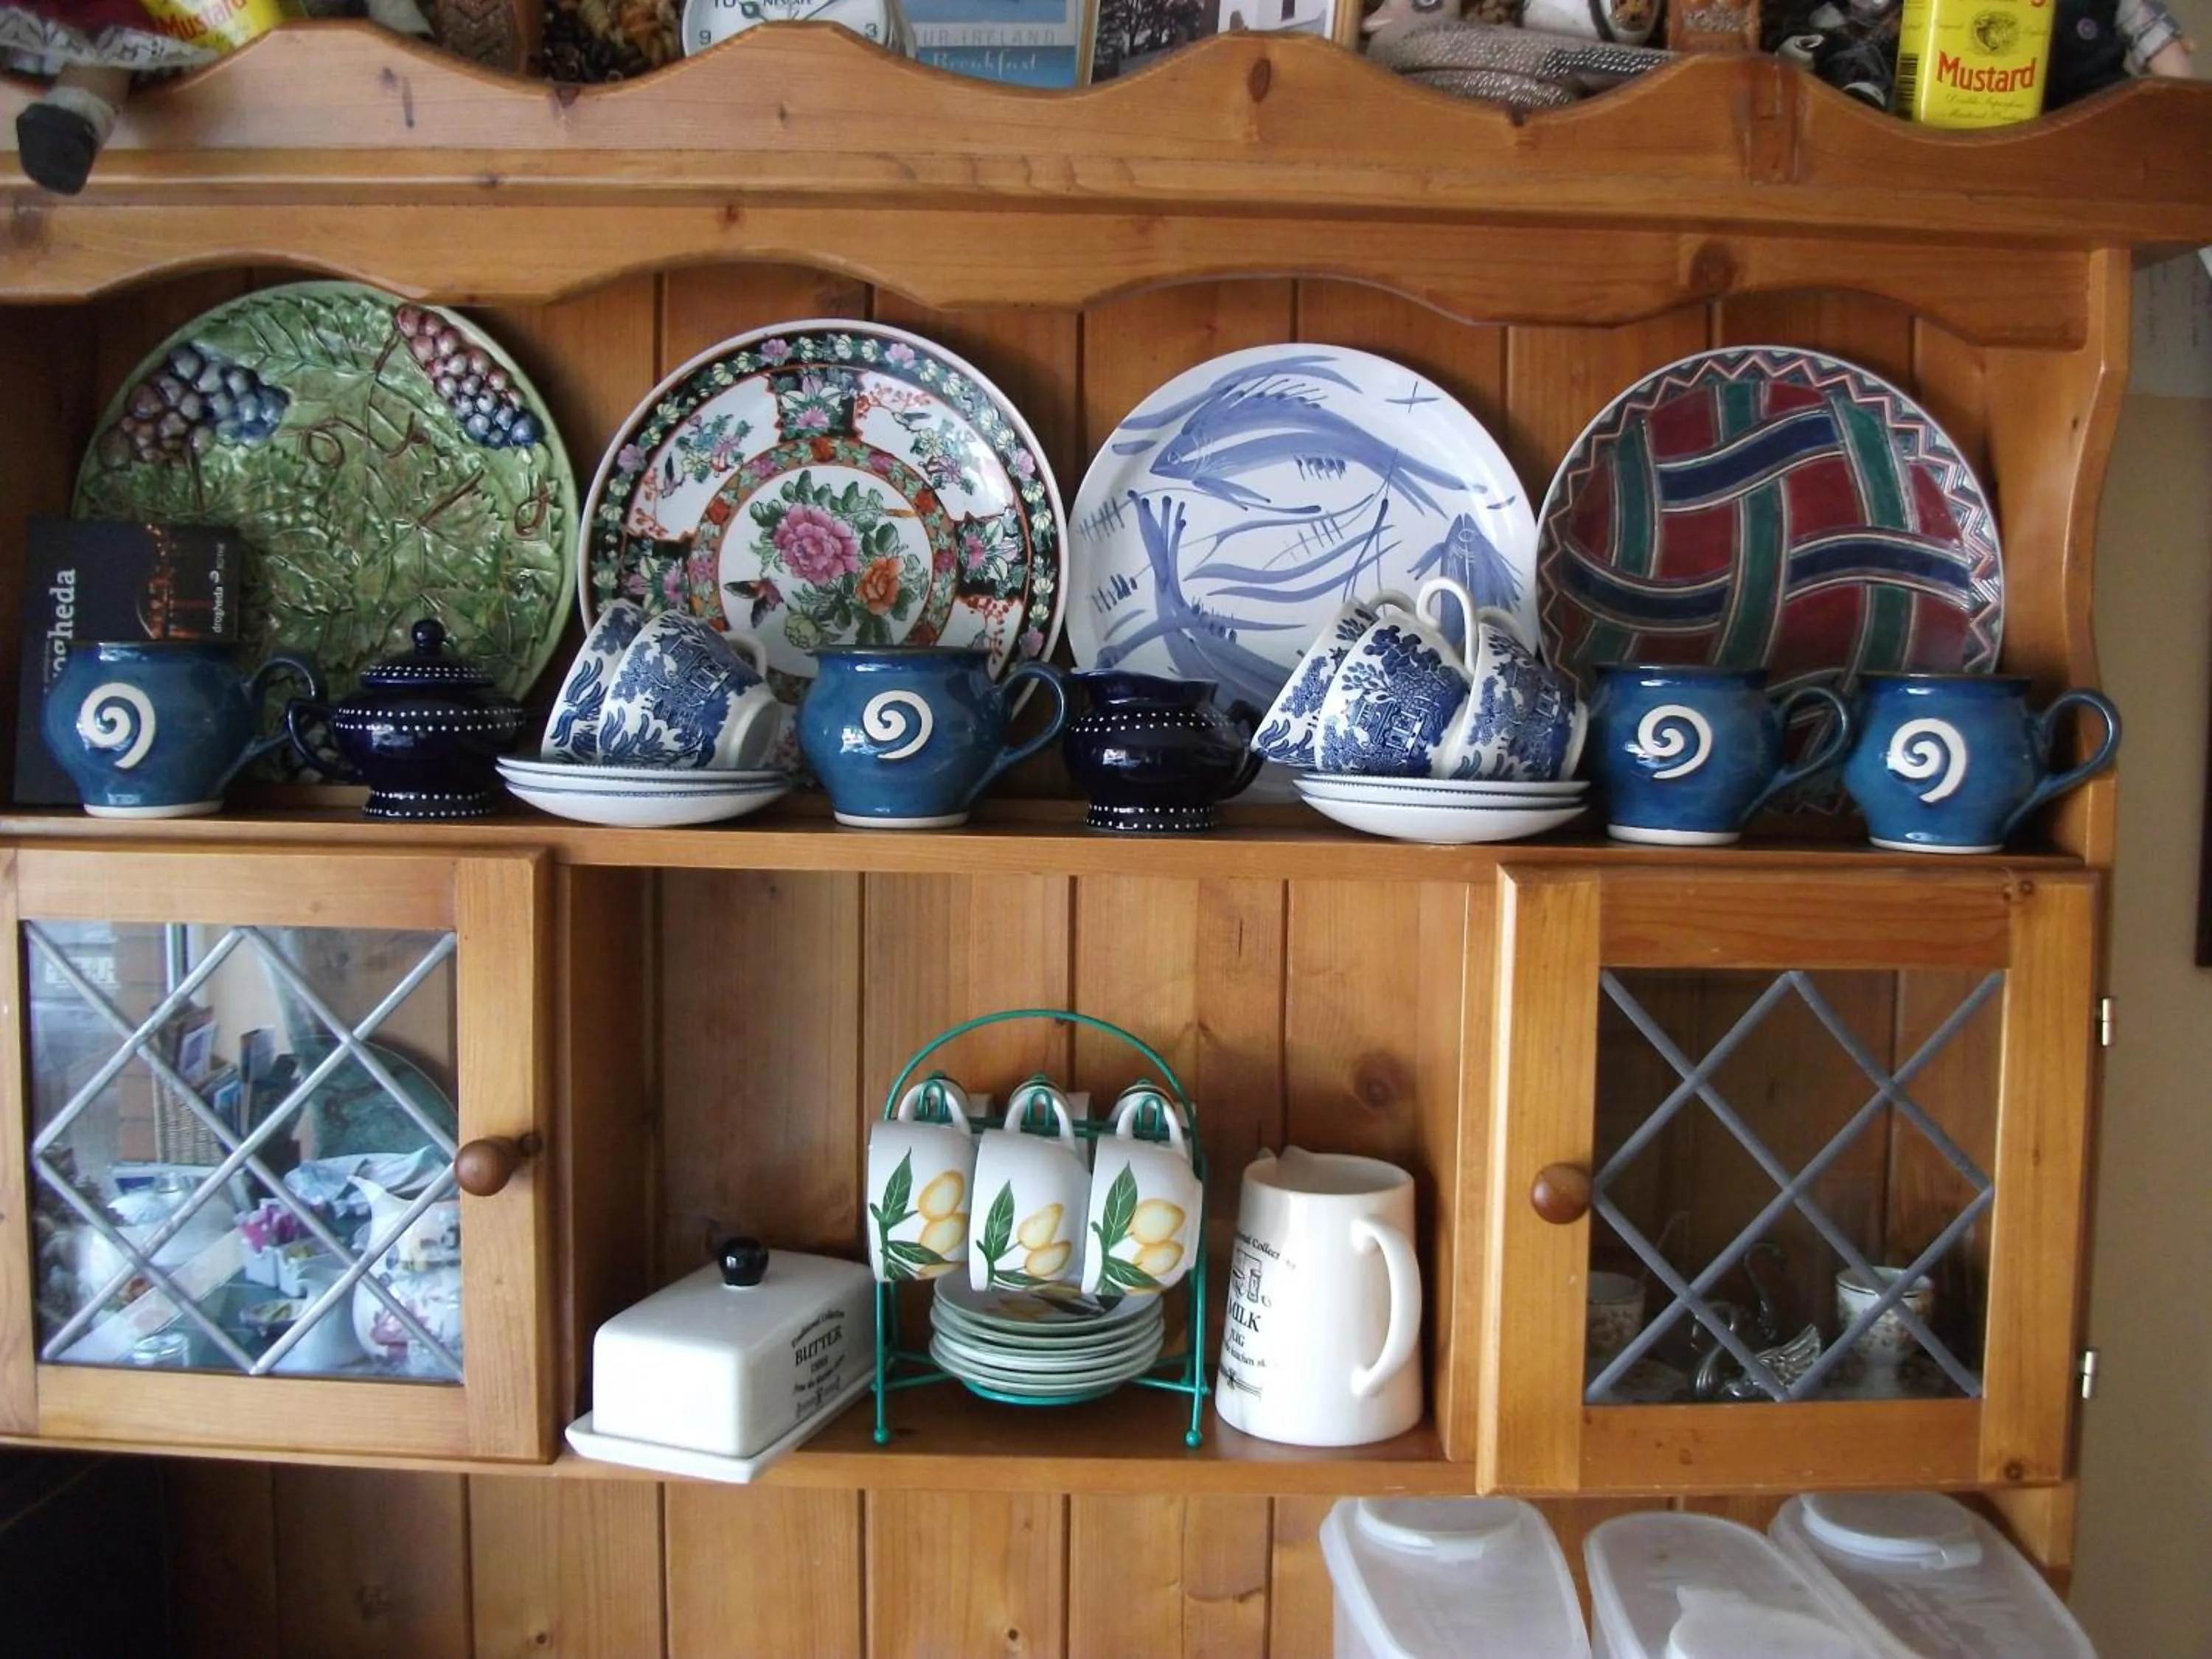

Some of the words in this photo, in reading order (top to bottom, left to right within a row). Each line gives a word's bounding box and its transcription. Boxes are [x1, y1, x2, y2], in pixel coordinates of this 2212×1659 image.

[699, 30, 712, 45] 9
[865, 23, 878, 37] 3
[1937, 49, 2038, 92] Mustard
[795, 1325, 842, 1367] BUTTER
